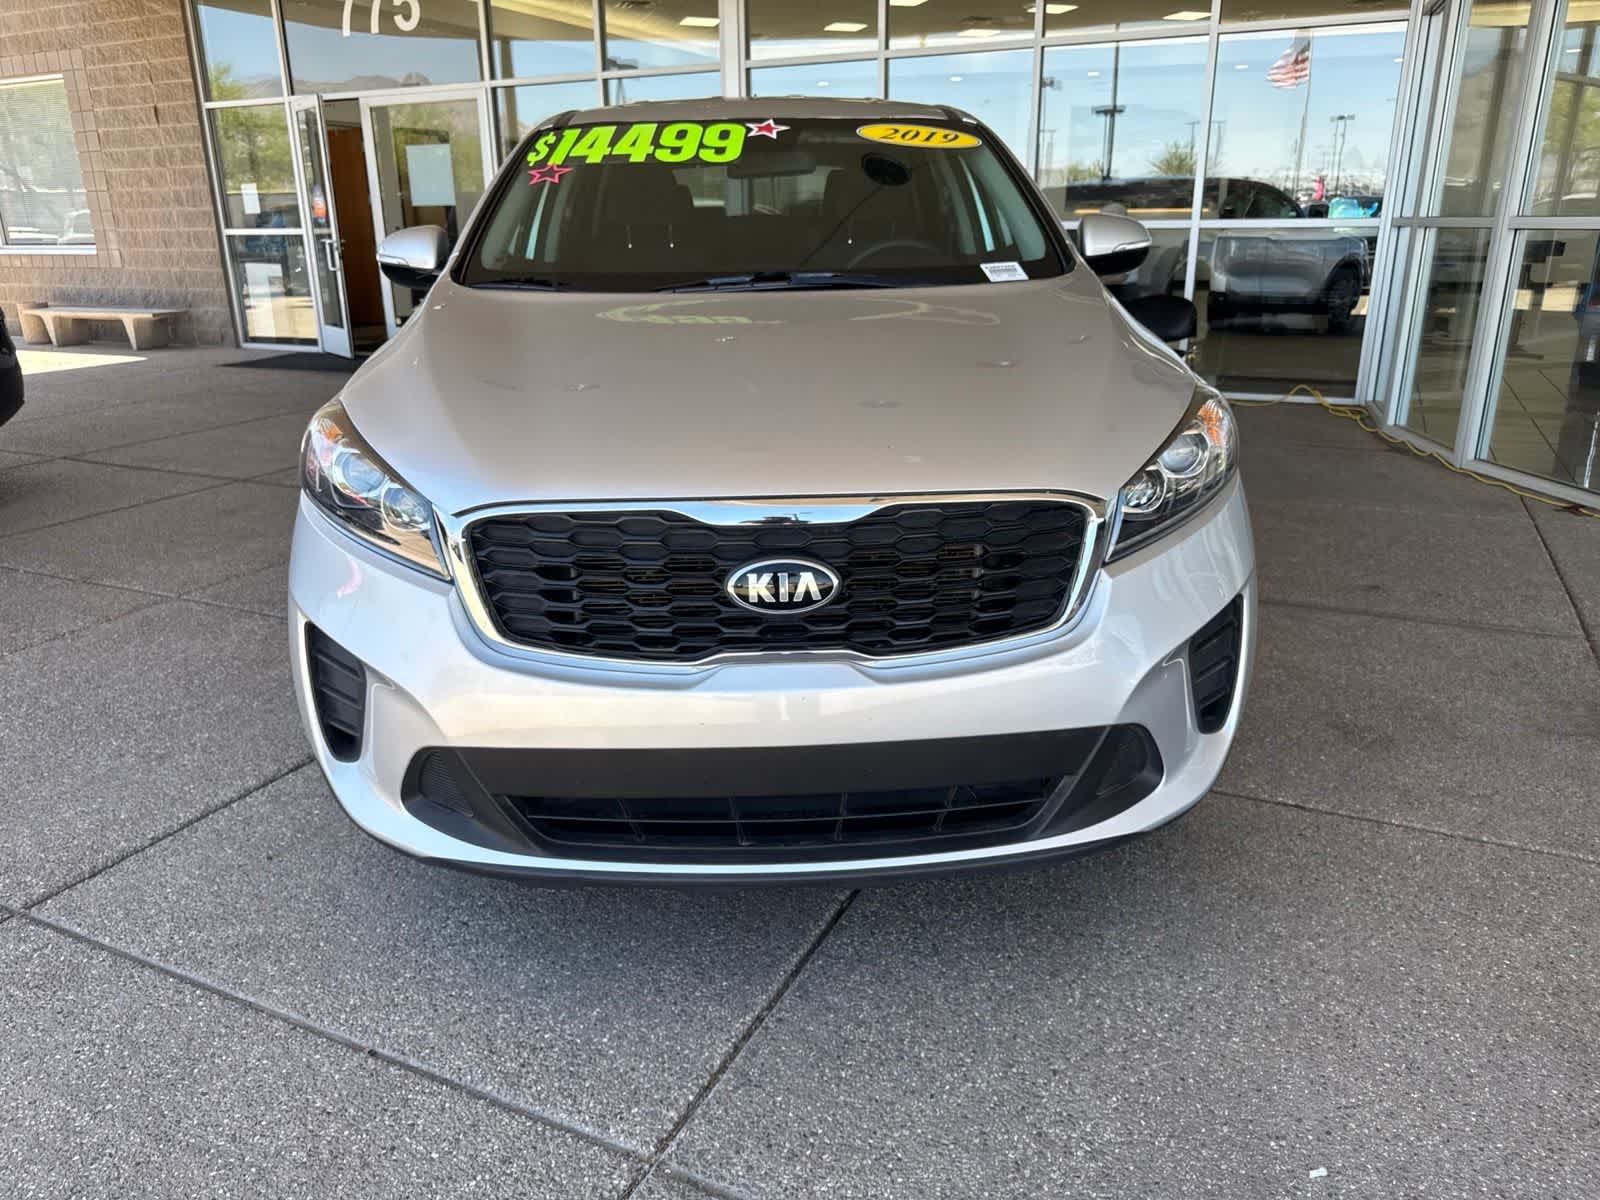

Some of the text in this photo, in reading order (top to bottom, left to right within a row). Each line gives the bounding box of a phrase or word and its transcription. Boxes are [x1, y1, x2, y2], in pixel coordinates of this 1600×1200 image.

[527, 123, 747, 166] $14499
[879, 127, 960, 143] 2019
[747, 572, 822, 602] KIA
